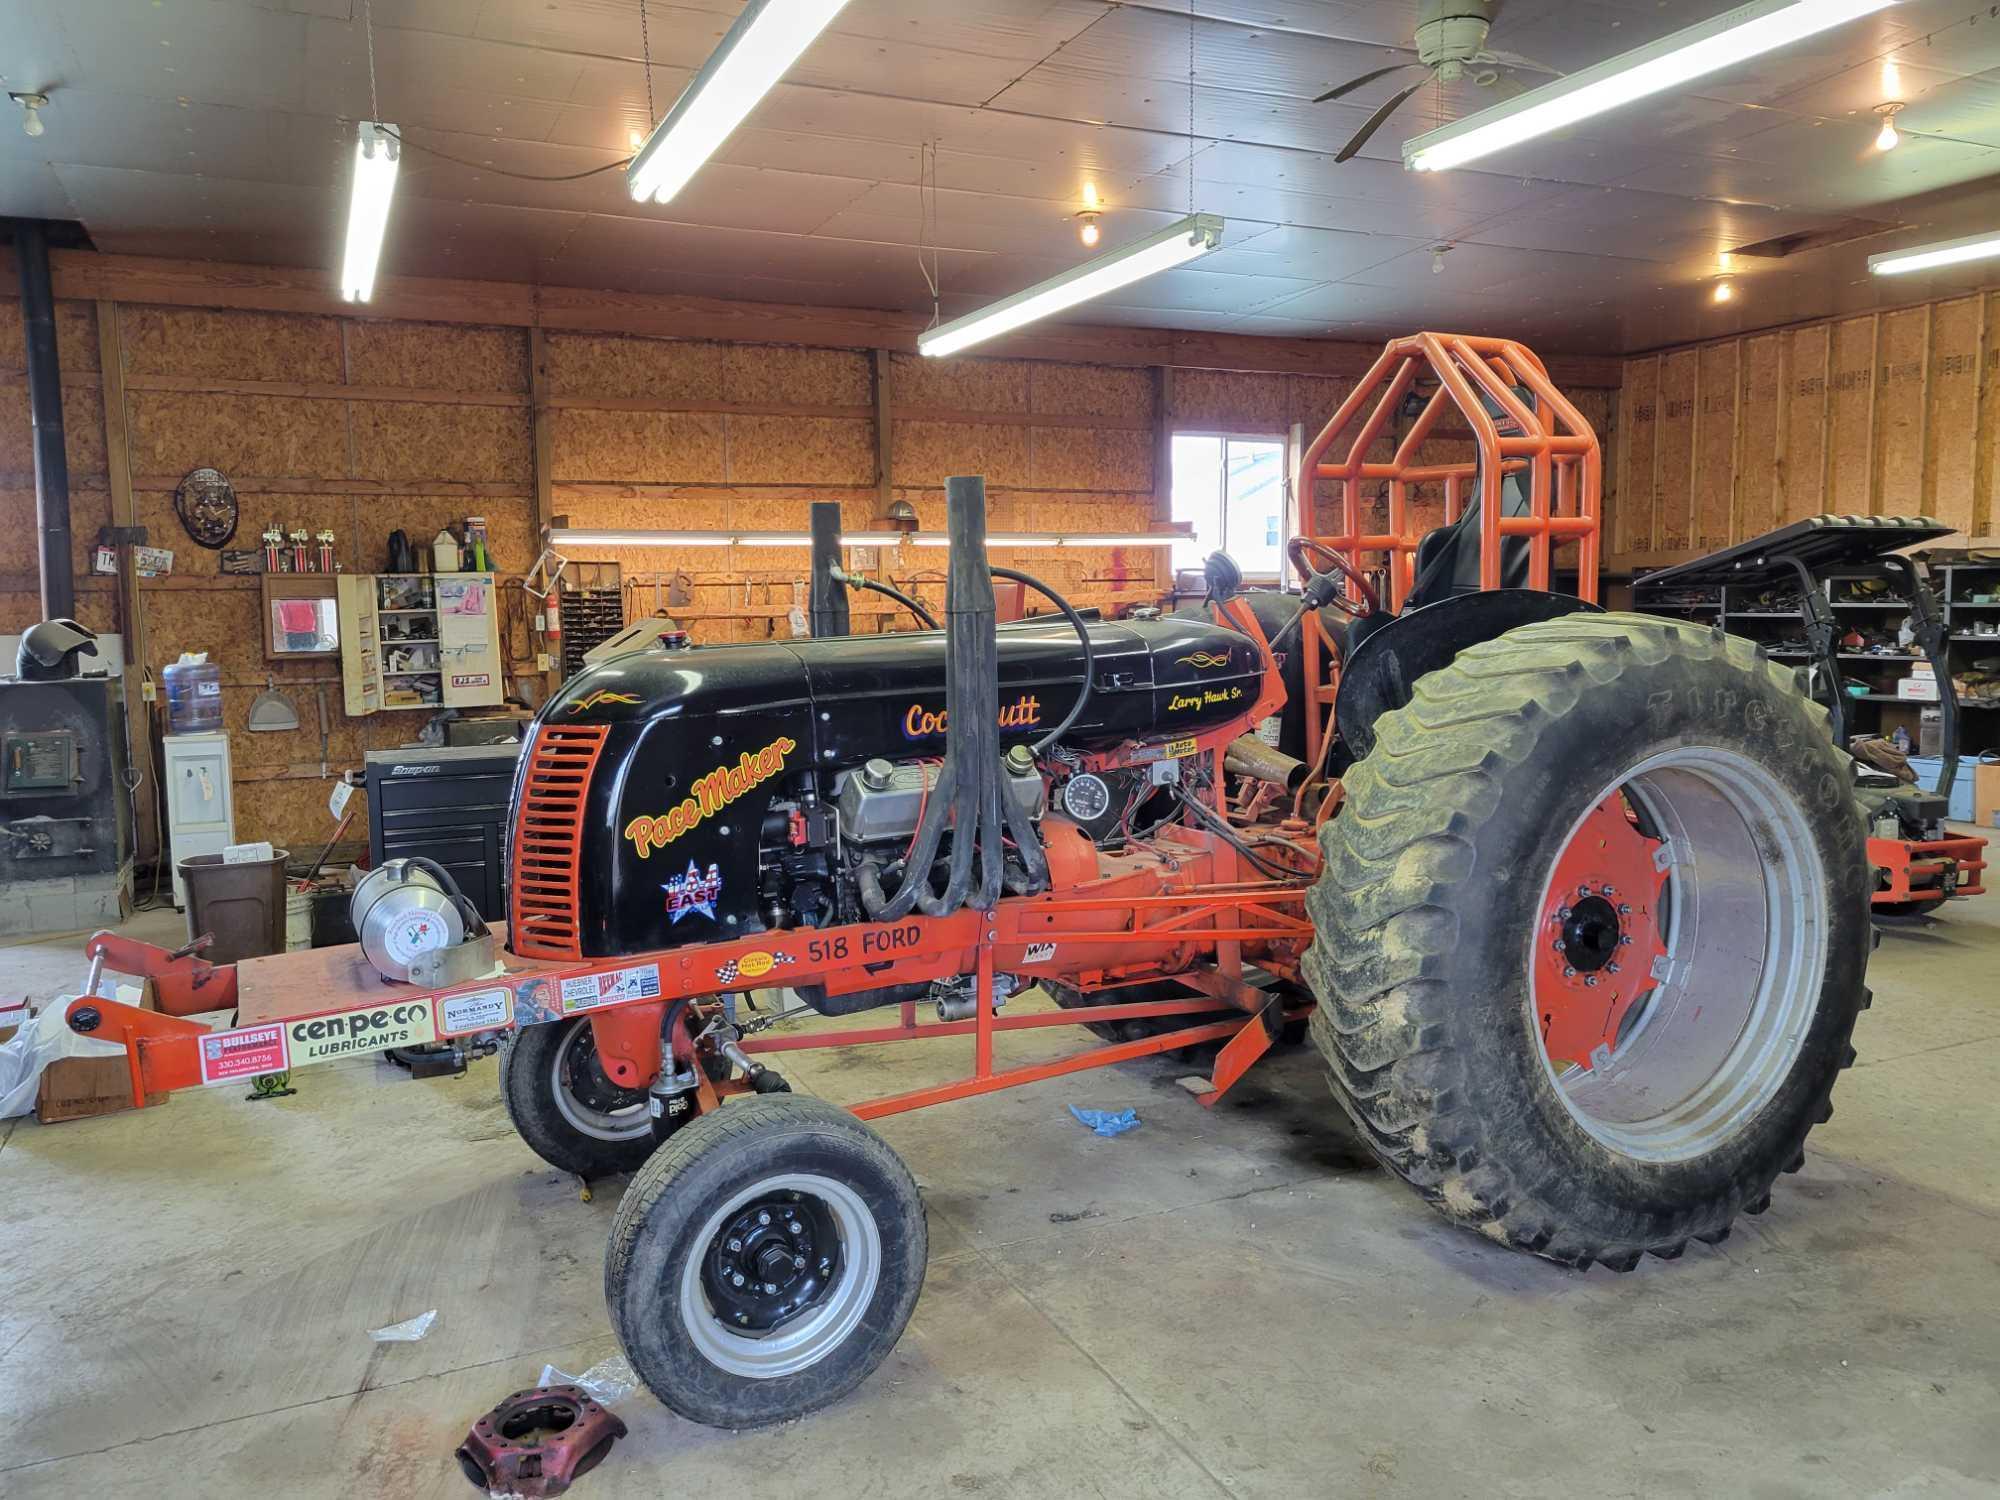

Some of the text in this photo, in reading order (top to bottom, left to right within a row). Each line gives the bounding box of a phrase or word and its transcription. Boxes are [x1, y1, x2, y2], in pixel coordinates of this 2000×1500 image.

[1168, 685, 1243, 711] Larry Hawk Sr.
[906, 696, 1041, 737] Cocutt
[625, 736, 796, 859] Pace Maker
[666, 886, 721, 913] EAST
[808, 925, 921, 962] 518 FORD
[563, 984, 597, 998] CHEVROLET
[223, 1030, 279, 1048] BULLSEYE
[308, 1030, 409, 1057] LUBRICANTS
